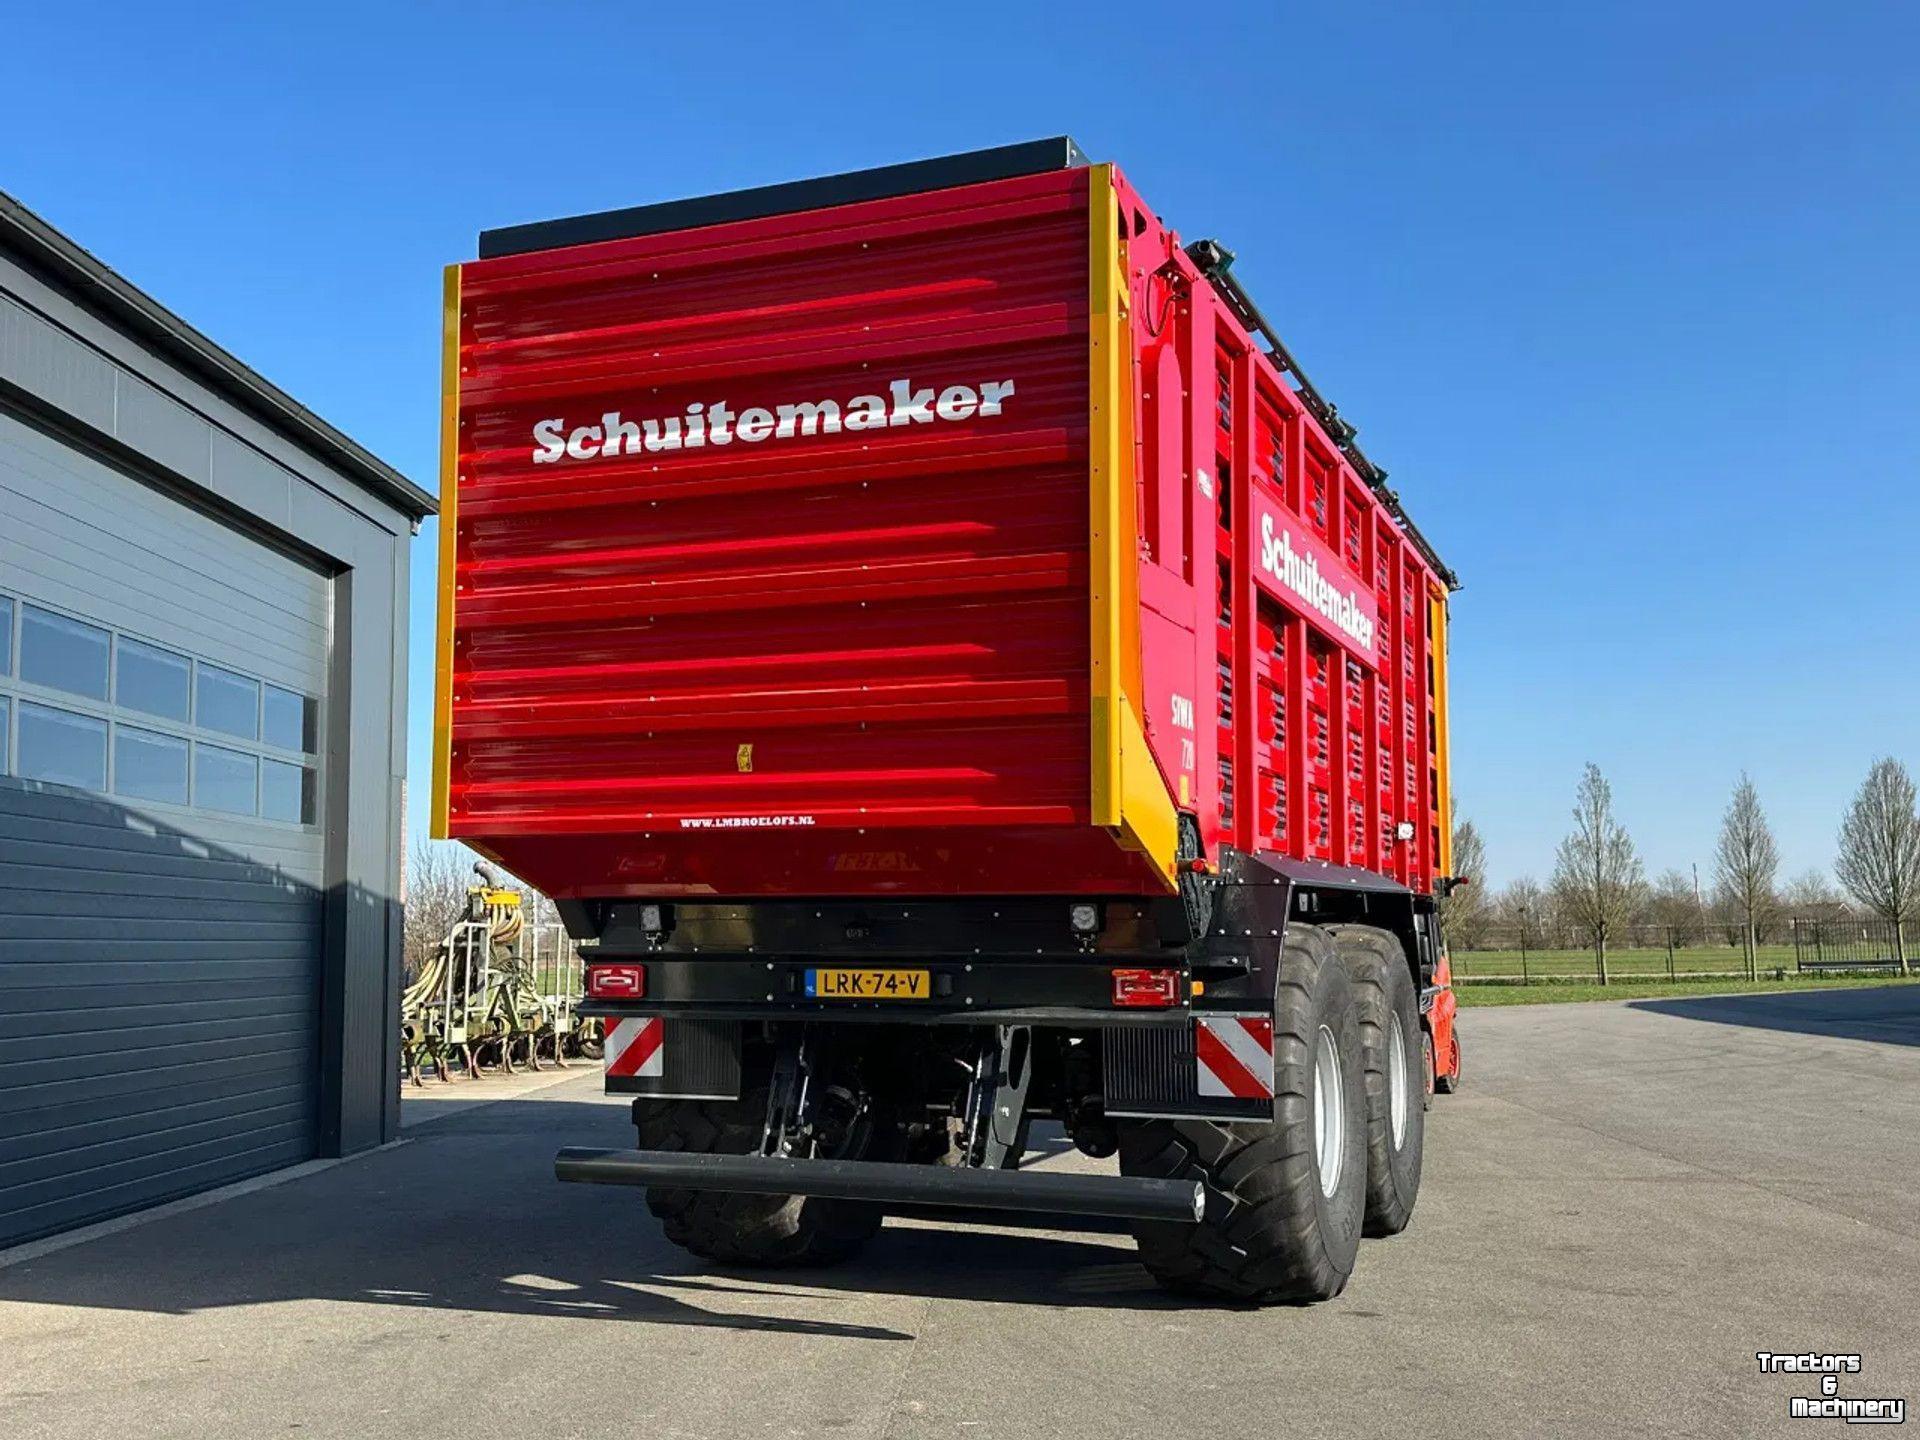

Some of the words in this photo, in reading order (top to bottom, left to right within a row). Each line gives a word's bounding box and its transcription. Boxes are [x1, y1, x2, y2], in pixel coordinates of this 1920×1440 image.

[533, 379, 1015, 463] Schuitemaker
[1261, 512, 1373, 650] Schuitemaker
[680, 815, 815, 828] WWW.LMBROELOFS.NL
[823, 973, 920, 994] LRK-74-V
